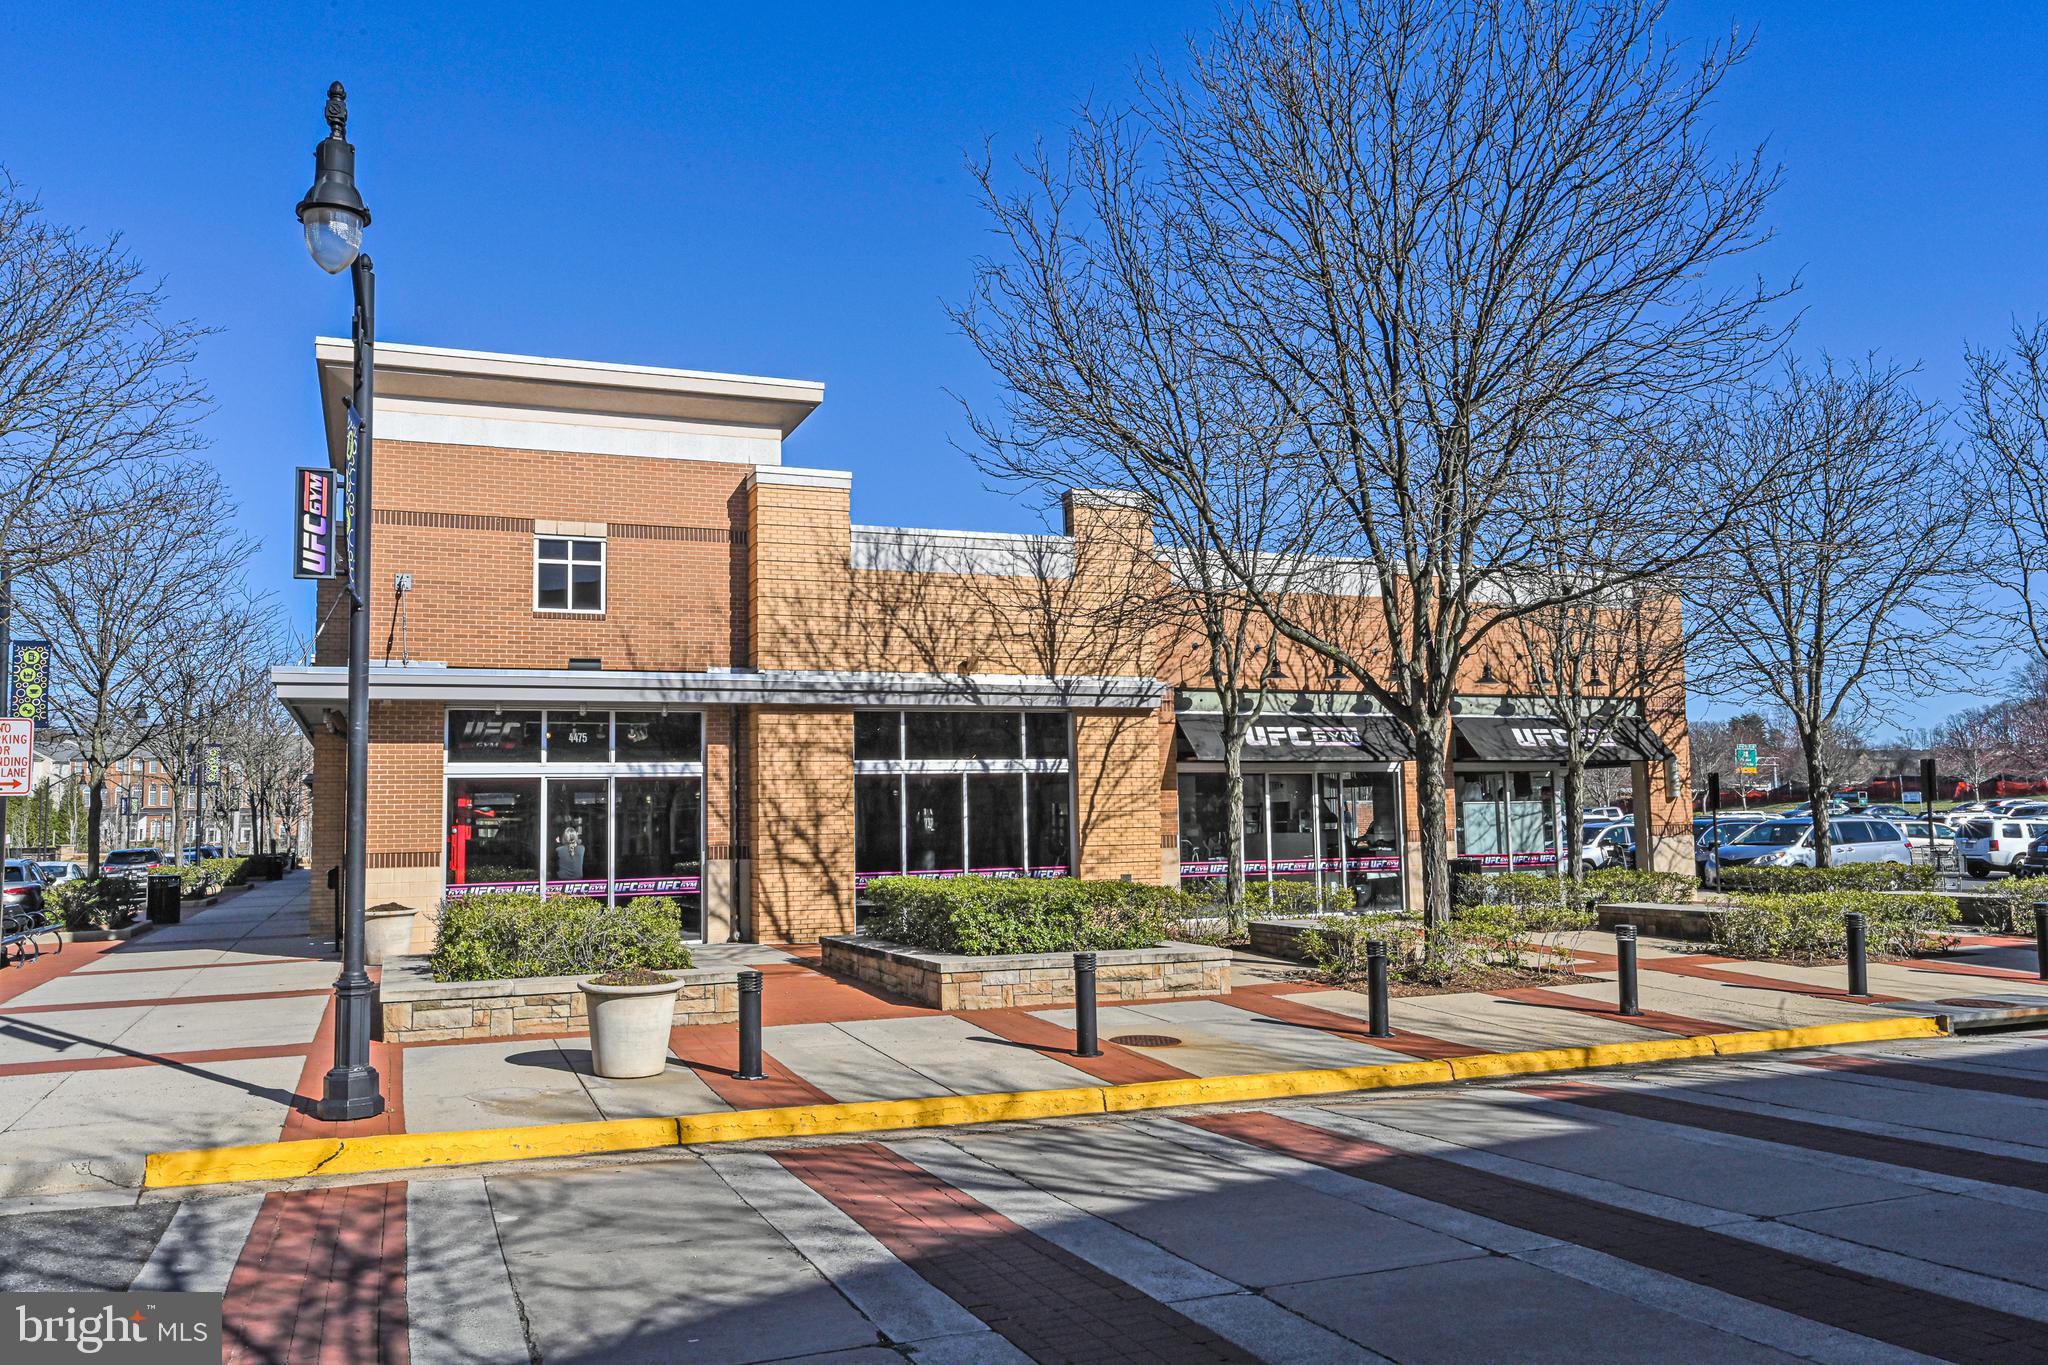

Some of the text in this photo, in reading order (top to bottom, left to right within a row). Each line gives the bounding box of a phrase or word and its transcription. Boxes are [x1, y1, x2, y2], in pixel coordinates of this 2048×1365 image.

[302, 472, 327, 574] UFC GYM
[0, 735, 27, 744] KING
[568, 732, 588, 743] 4475
[1245, 726, 1361, 746] UFC GYM
[1511, 728, 1569, 747] UFC
[0, 746, 10, 755] R
[1, 768, 26, 777] LANE
[1277, 863, 1294, 871] UFC
[564, 884, 590, 894] UFC
[615, 882, 639, 892] UFC
[657, 881, 681, 891] UFC
[680, 881, 698, 889] GYM
